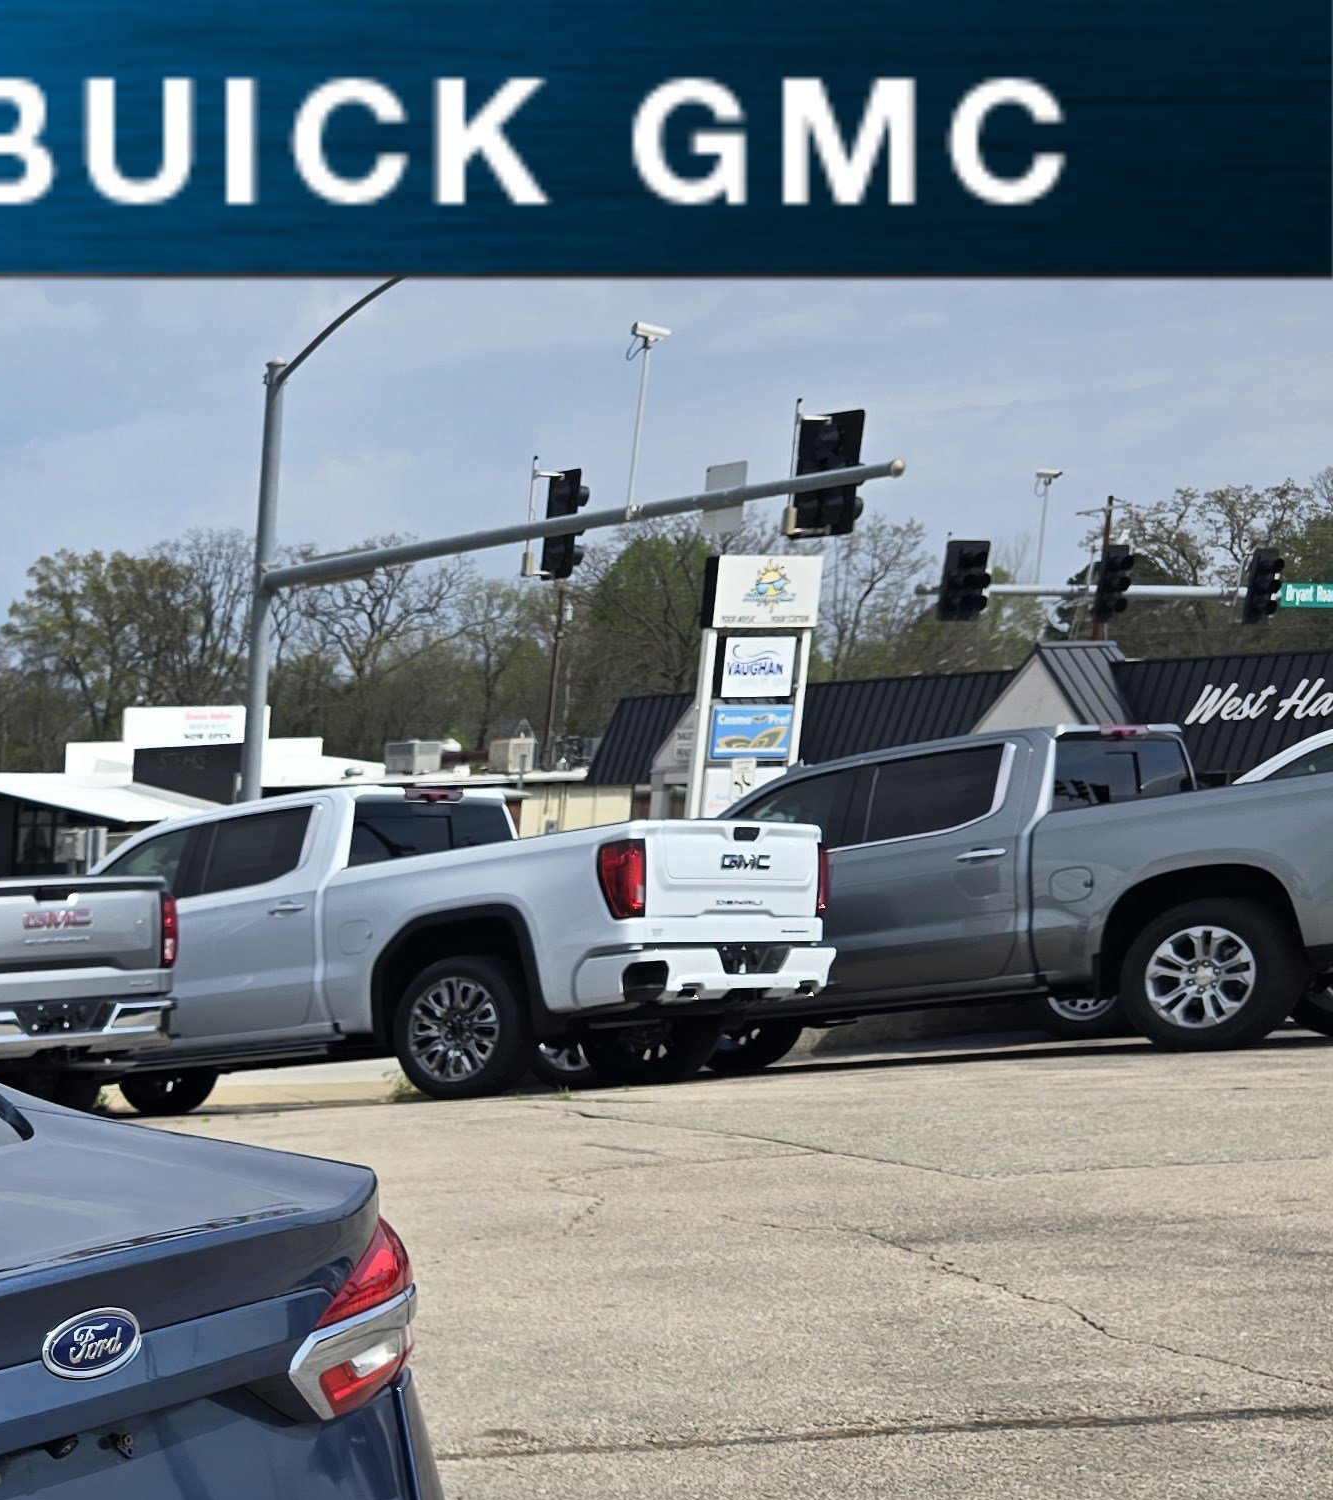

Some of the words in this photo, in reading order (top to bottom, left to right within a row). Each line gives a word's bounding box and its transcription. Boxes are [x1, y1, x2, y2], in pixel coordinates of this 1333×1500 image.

[1286, 584, 1314, 606] Bryant
[727, 662, 784, 677] VAUGHAN
[1184, 683, 1277, 725] West
[720, 854, 771, 870] GMC
[23, 909, 93, 930] GMC
[69, 1322, 123, 1364] Ford
